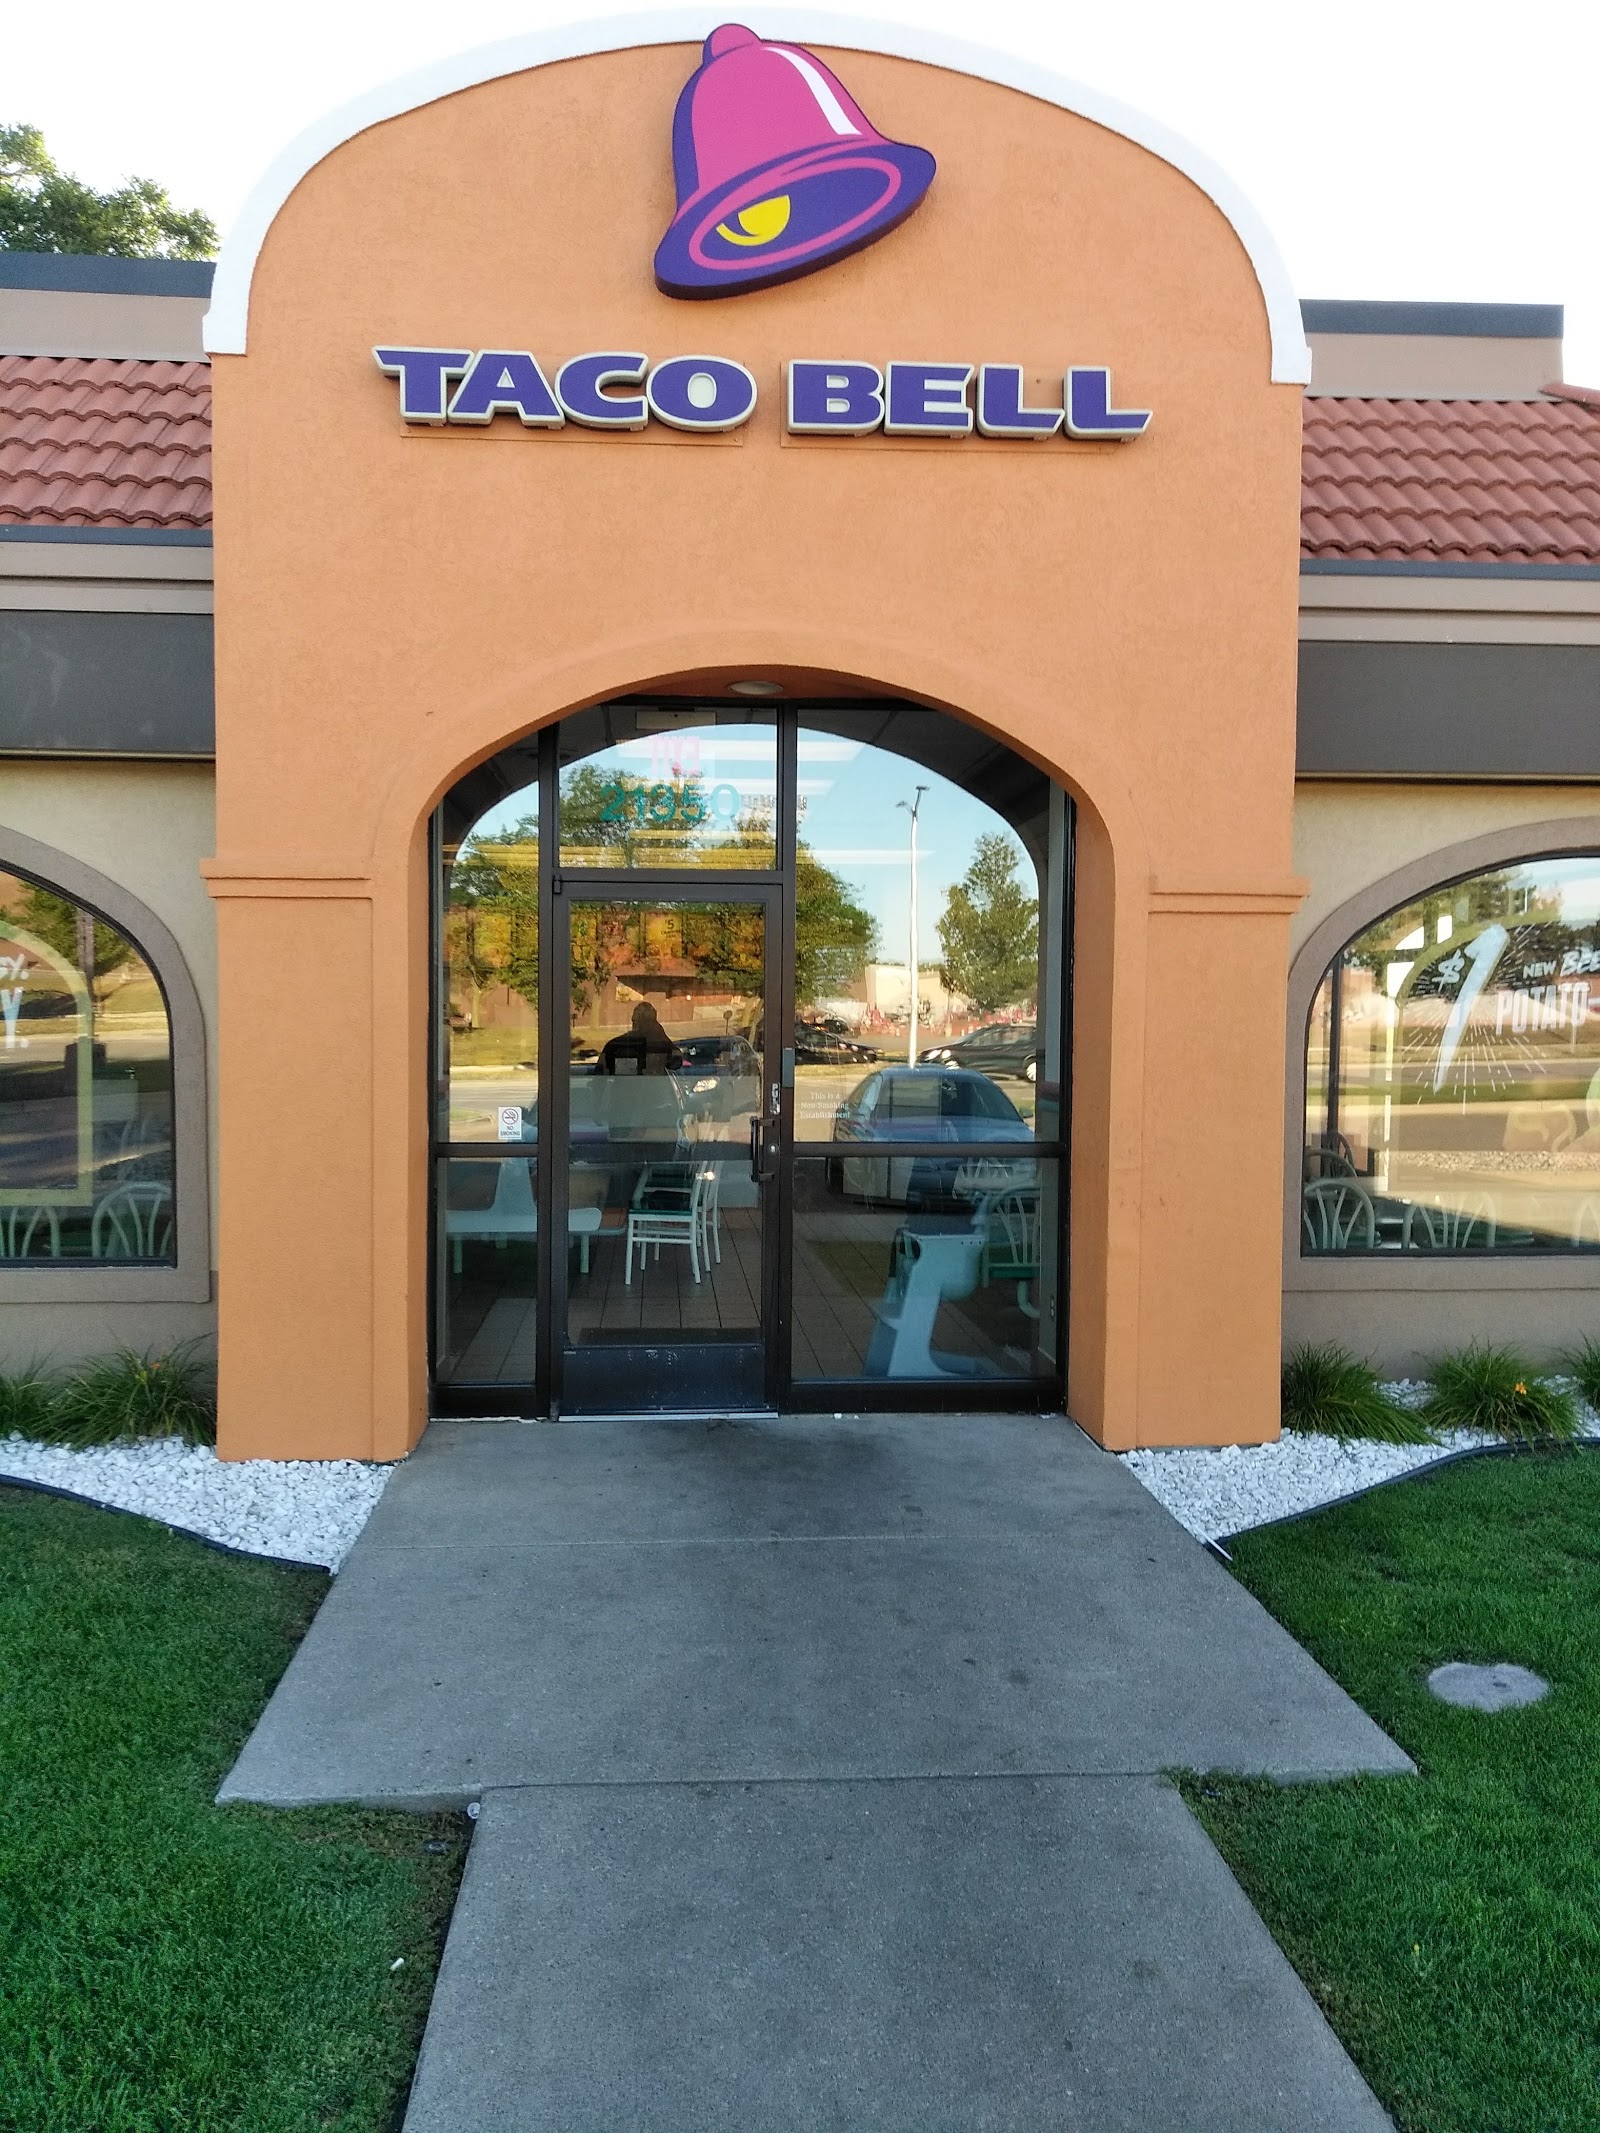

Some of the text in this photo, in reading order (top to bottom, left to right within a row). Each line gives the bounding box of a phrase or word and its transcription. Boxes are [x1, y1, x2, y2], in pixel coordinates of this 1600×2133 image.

[372, 346, 1154, 441] TACO BELL
[600, 784, 741, 821] 21350
[1523, 961, 1557, 979] NEW
[1495, 982, 1590, 1036] POTATO
[800, 1111, 851, 1119] Establishment
